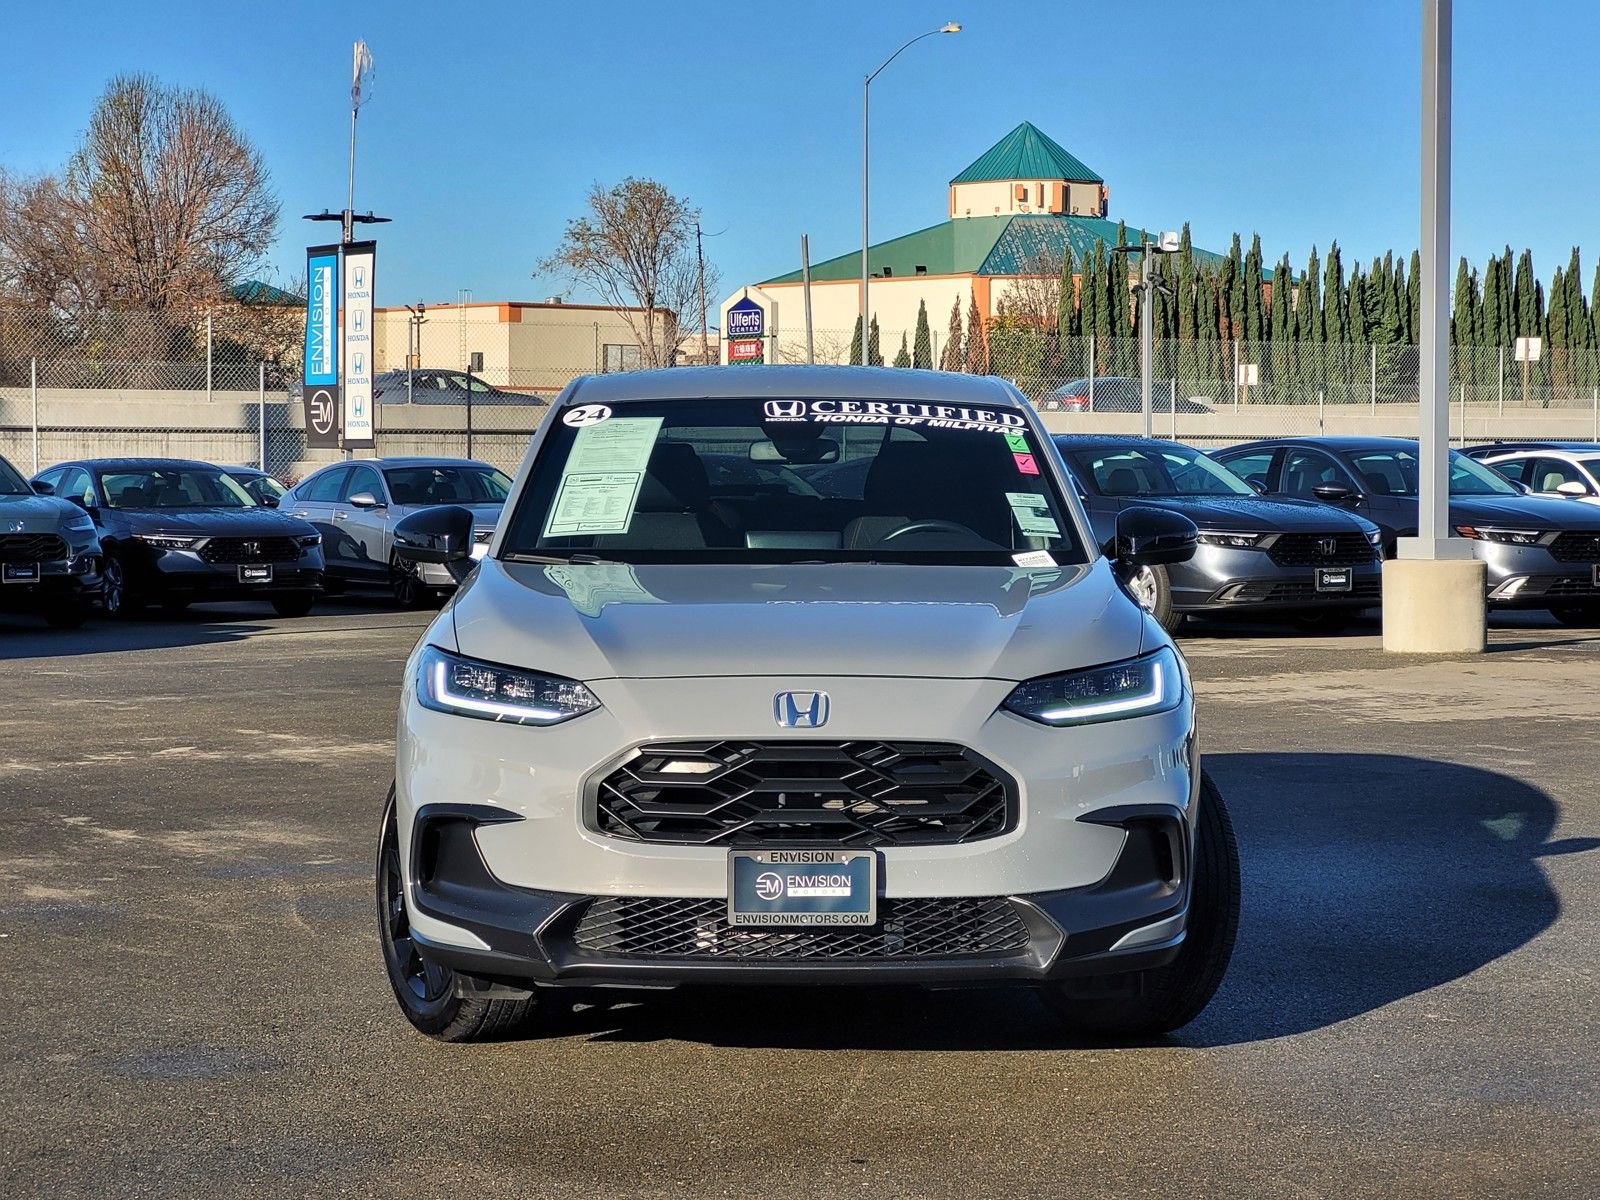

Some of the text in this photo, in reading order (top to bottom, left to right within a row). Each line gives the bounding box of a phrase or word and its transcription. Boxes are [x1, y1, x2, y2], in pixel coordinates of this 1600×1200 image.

[311, 266, 325, 375] ENVISION
[730, 312, 760, 327] Ulferts
[569, 407, 606, 423] 24
[811, 400, 1026, 428] CERTIFIED
[814, 414, 1025, 436] HONDA OF MILPITAS
[770, 852, 835, 863] ENVISION
[787, 875, 851, 887] ENVISION
[735, 914, 869, 924] ENVISIONMOTORS.COM
